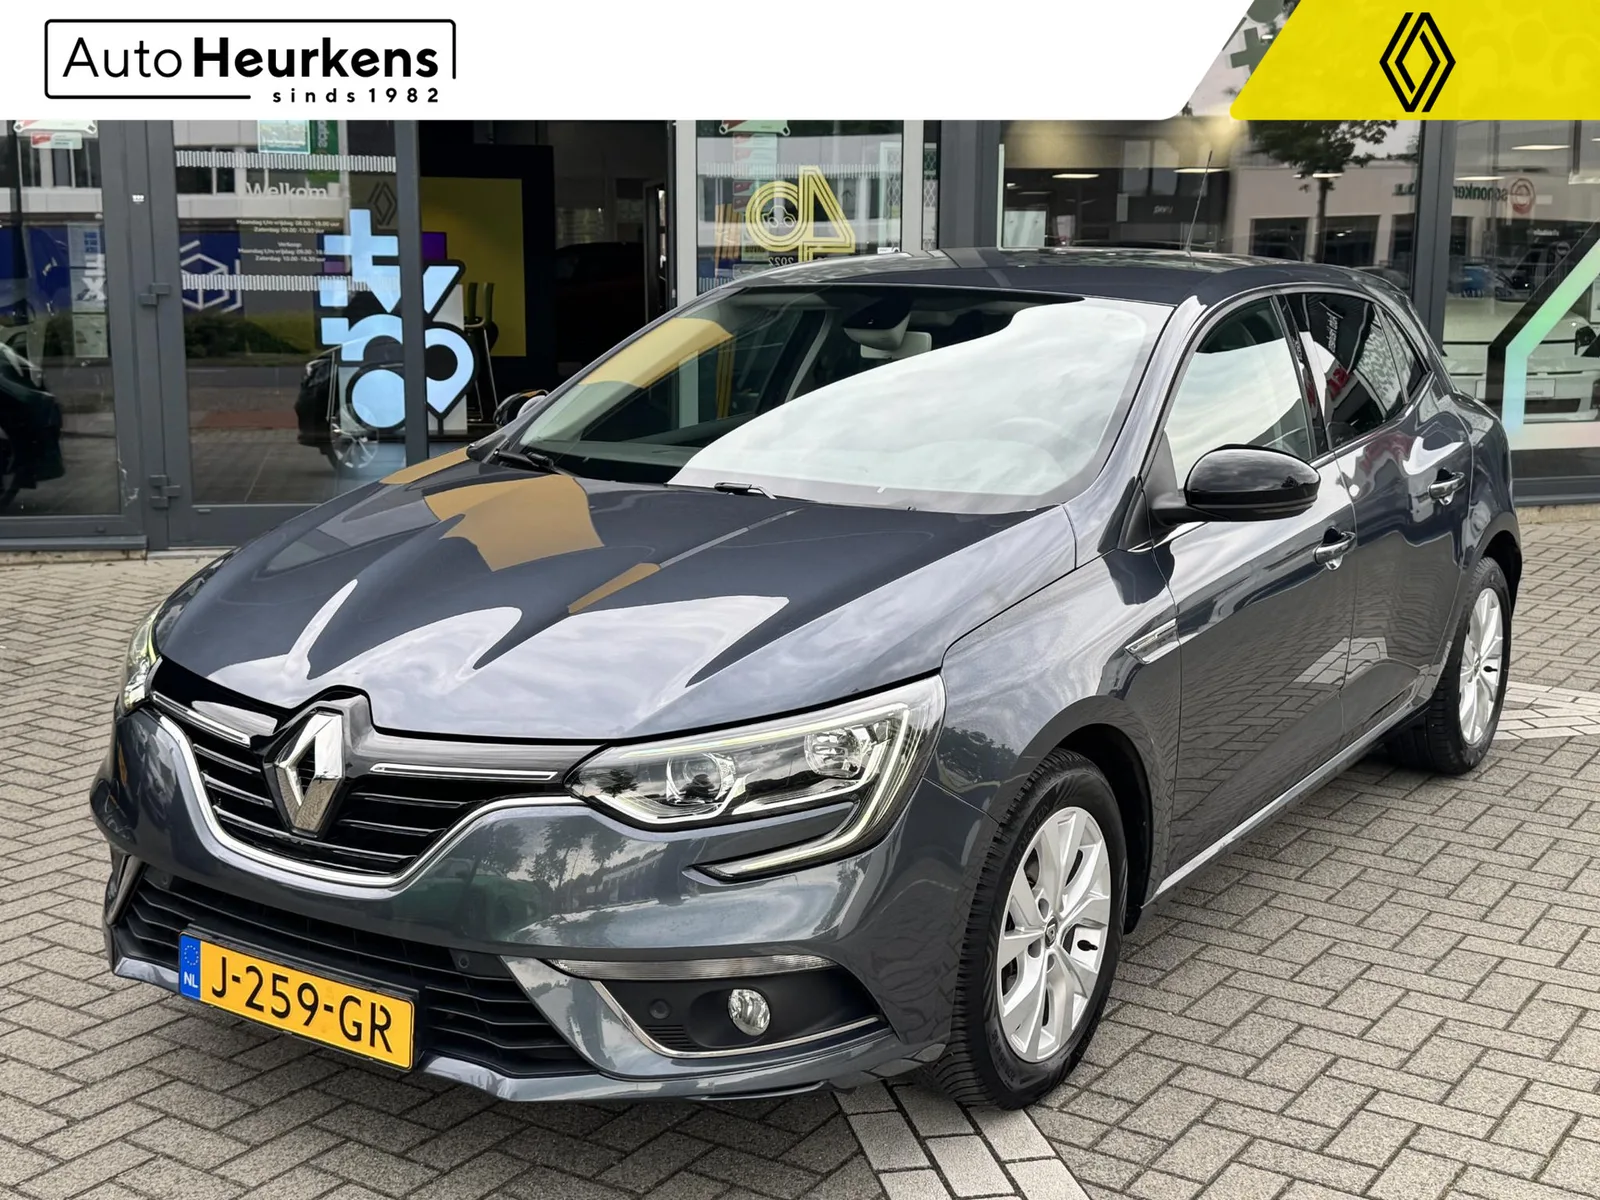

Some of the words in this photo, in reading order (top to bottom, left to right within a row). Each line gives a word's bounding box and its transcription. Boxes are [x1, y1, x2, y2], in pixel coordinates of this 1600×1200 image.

[246, 182, 328, 198] Welkom
[183, 971, 199, 989] NL
[212, 956, 393, 1054] J-259-GR
